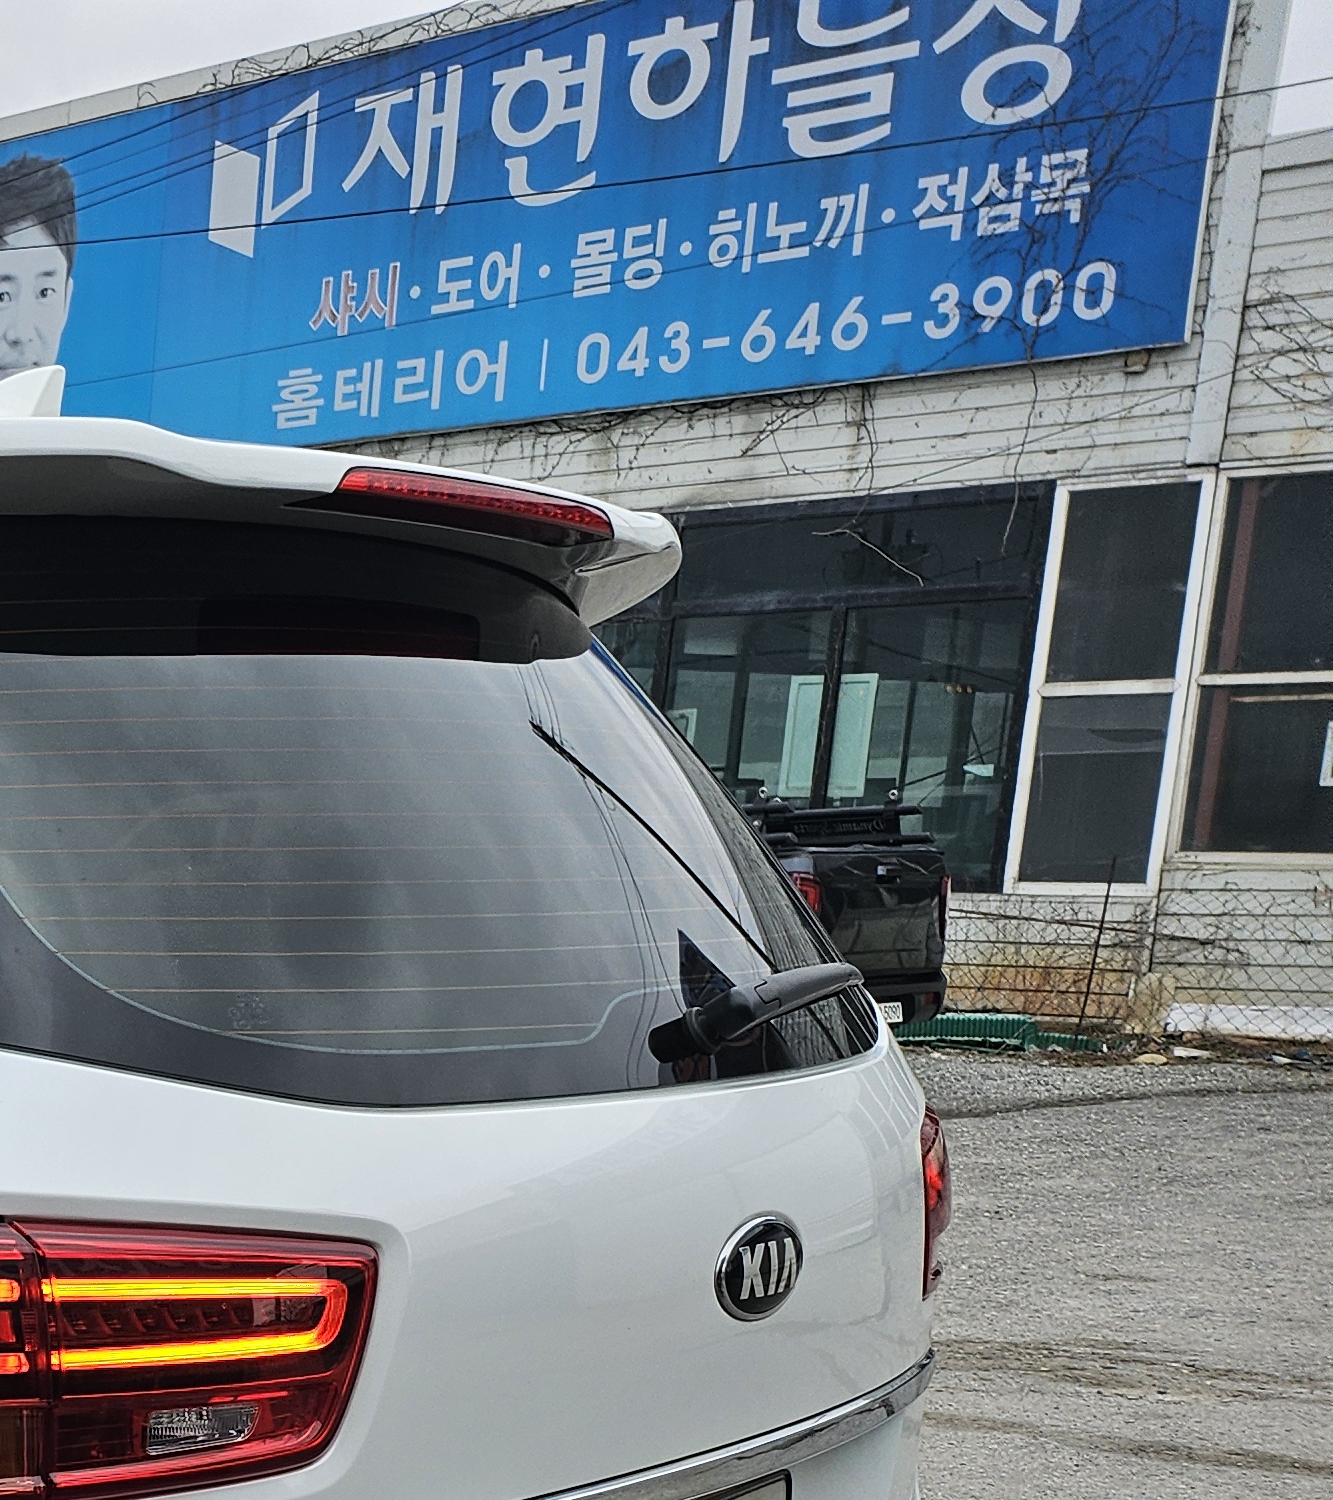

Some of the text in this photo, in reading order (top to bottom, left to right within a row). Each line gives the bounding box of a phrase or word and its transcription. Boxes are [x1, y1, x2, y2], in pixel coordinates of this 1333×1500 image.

[272, 260, 1118, 430] 홈테리어 043-646-3900
[738, 1237, 801, 1300] KIA
